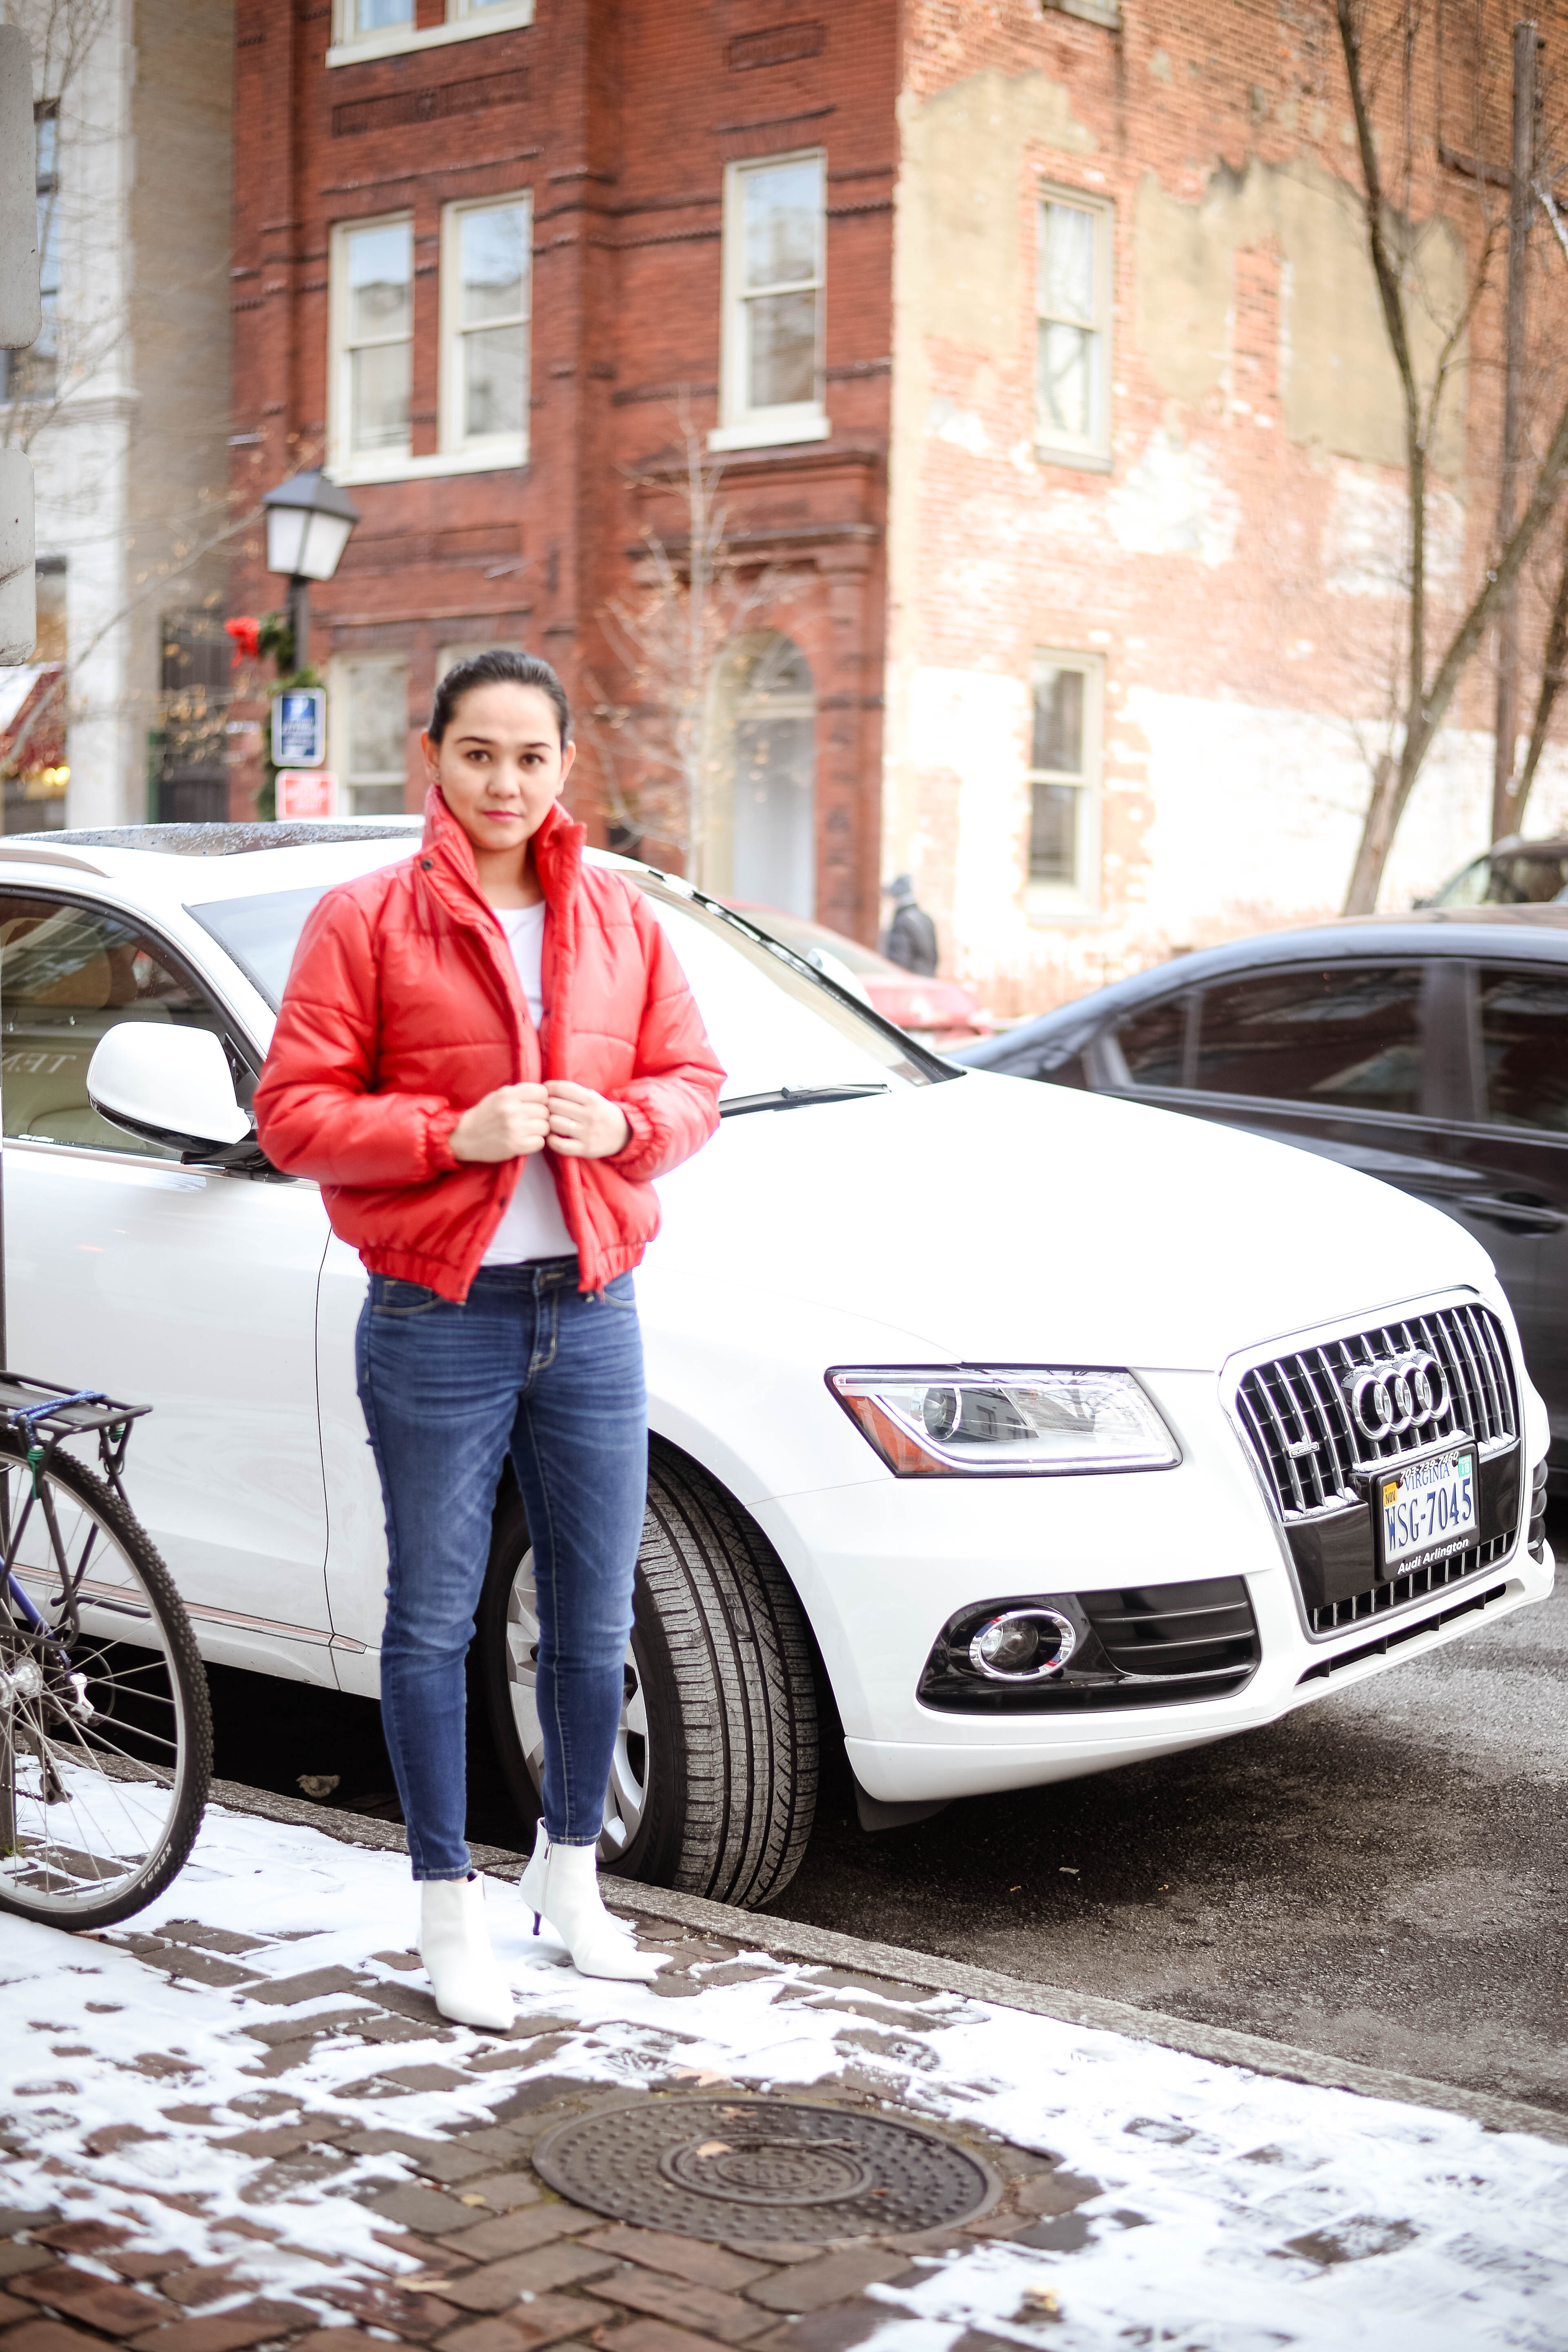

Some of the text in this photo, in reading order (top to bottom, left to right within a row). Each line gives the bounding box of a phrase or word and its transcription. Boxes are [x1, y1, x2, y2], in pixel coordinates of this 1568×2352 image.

[1292, 1445, 1317, 1456] quattro
[1400, 1451, 1459, 1480] 703-739-7460
[1404, 1463, 1450, 1491] VIRGINIA
[1461, 1463, 1470, 1474] 18
[1386, 1490, 1395, 1504] NOV
[1385, 1477, 1471, 1551] WSG-7045
[1397, 1539, 1469, 1575] Audi Arlington
[141, 1842, 172, 1889] KENDA
